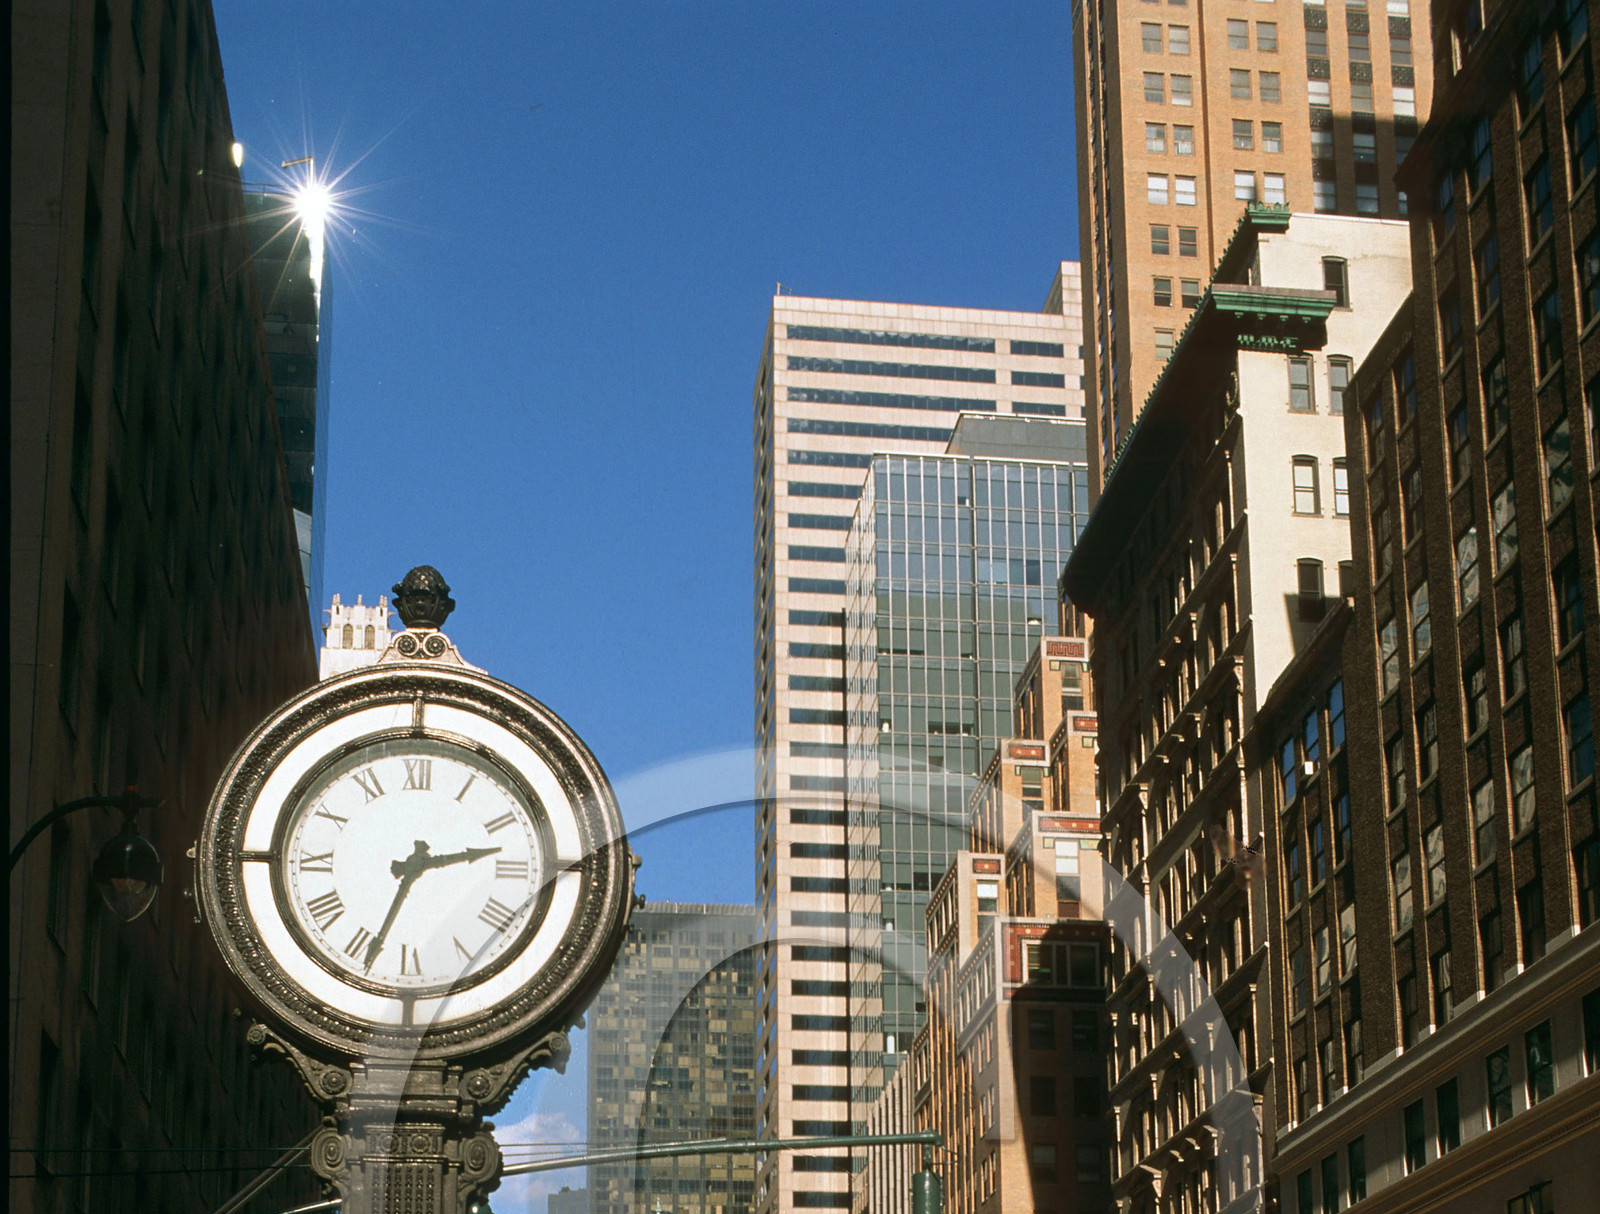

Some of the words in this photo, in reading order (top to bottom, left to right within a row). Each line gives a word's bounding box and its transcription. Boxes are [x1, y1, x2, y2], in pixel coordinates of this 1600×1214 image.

[352, 767, 385, 804] XI
[402, 759, 432, 791] XII
[454, 774, 478, 804] I
[315, 803, 349, 831] X
[484, 811, 517, 834] II
[299, 850, 334, 873] IX
[496, 859, 528, 879] III
[306, 887, 345, 933] VIII
[401, 943, 423, 976] VI
[452, 934, 474, 962] V
